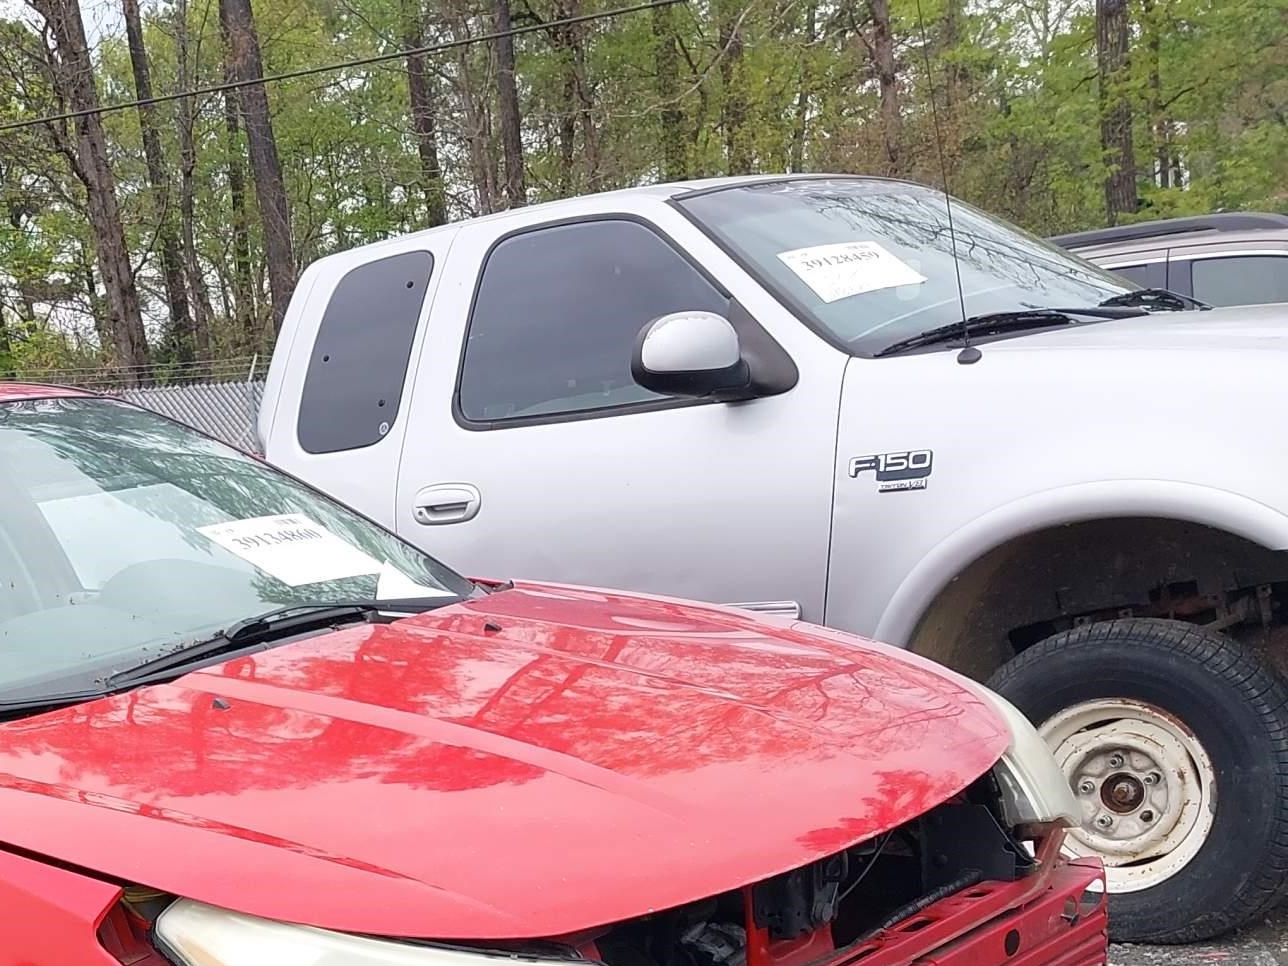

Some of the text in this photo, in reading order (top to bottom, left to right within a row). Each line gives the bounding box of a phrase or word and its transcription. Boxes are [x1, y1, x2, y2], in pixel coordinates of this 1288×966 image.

[800, 250, 881, 272] 39128459
[848, 449, 933, 478] F-150
[231, 527, 324, 551] 39134860
